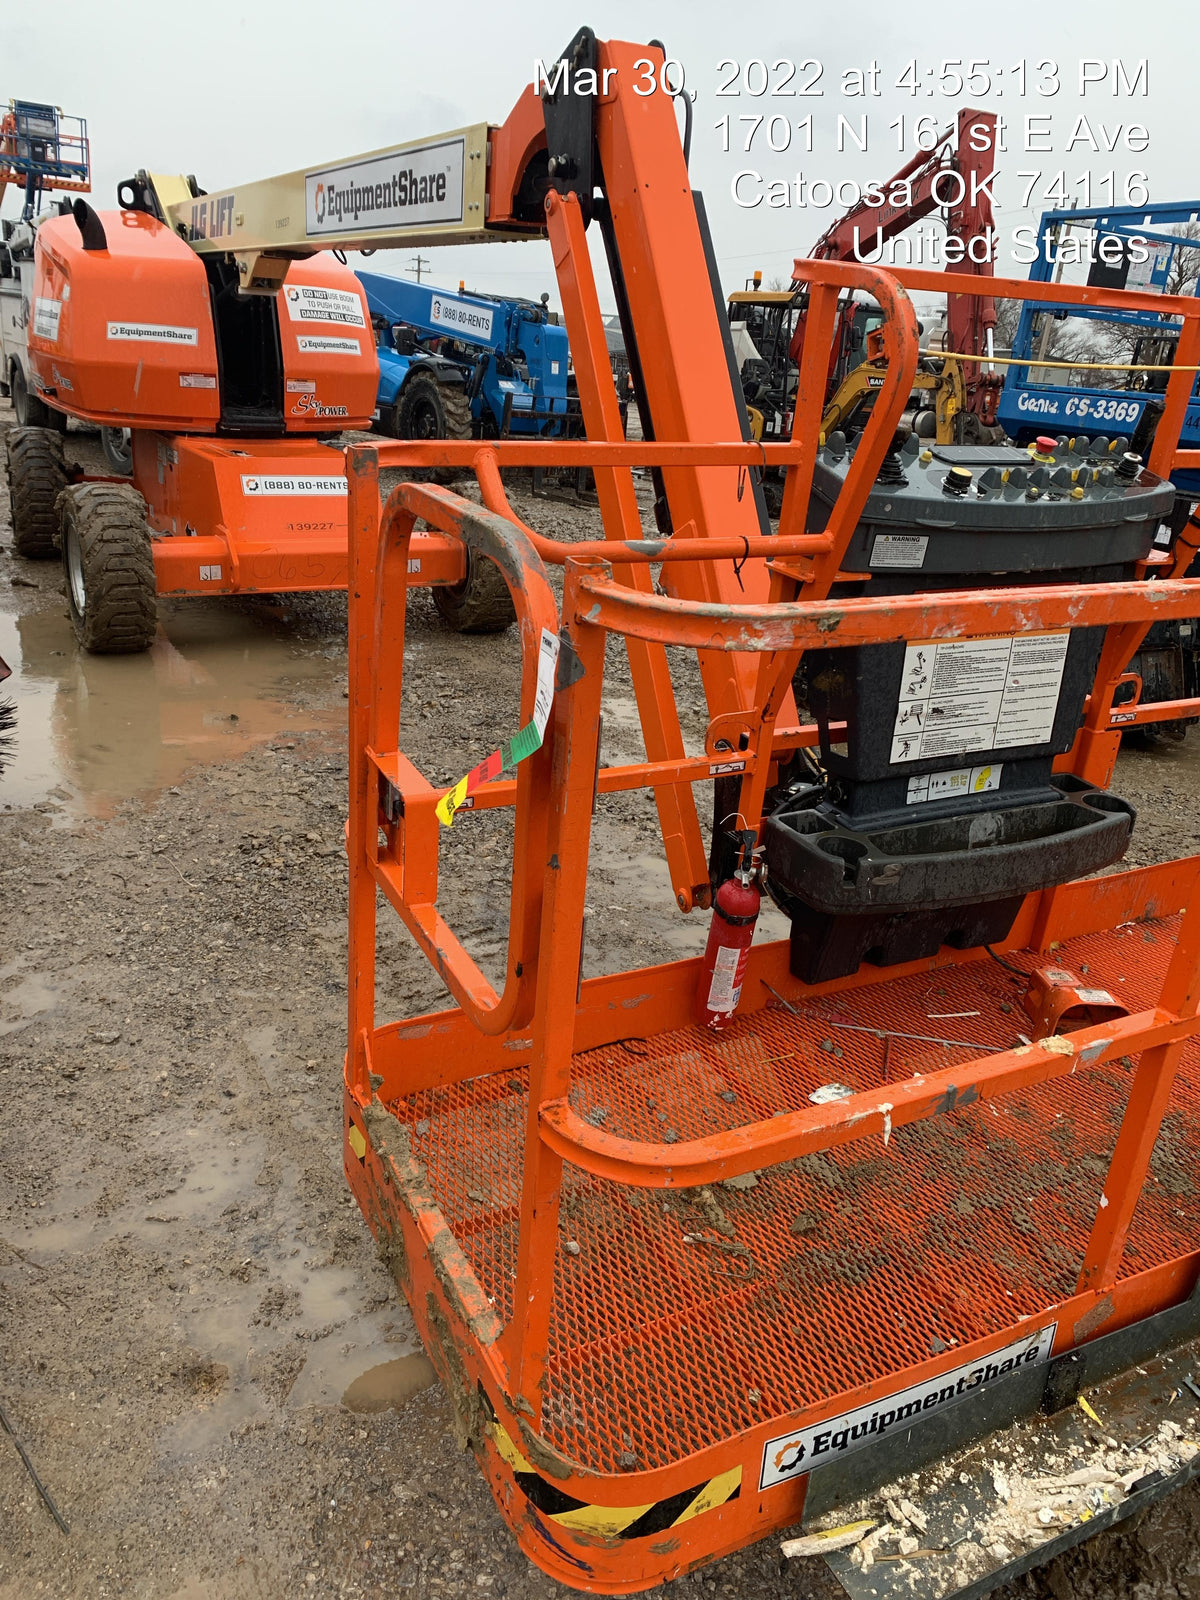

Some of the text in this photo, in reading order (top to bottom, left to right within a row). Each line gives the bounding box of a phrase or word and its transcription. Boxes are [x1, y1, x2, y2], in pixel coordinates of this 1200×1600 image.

[328, 168, 447, 222] EquipmentShare
[209, 194, 235, 239] LIFT
[303, 290, 355, 303] DO NOT USE BOOM
[307, 300, 316, 308] TO
[316, 302, 333, 310] PUSH
[333, 303, 341, 311] OR
[301, 310, 363, 324] DAMAGE WILL OCCUR
[442, 304, 491, 331] (888) 80-RENTS
[119, 327, 193, 341] EquipmentShare
[307, 340, 358, 351] EquipmentShare
[869, 378, 886, 387] SAN
[1065, 397, 1140, 423] GS-3369
[264, 480, 349, 491] (888) 80-RENTS
[288, 522, 334, 531] 139227
[810, 1344, 1040, 1458] EquipmentShare
